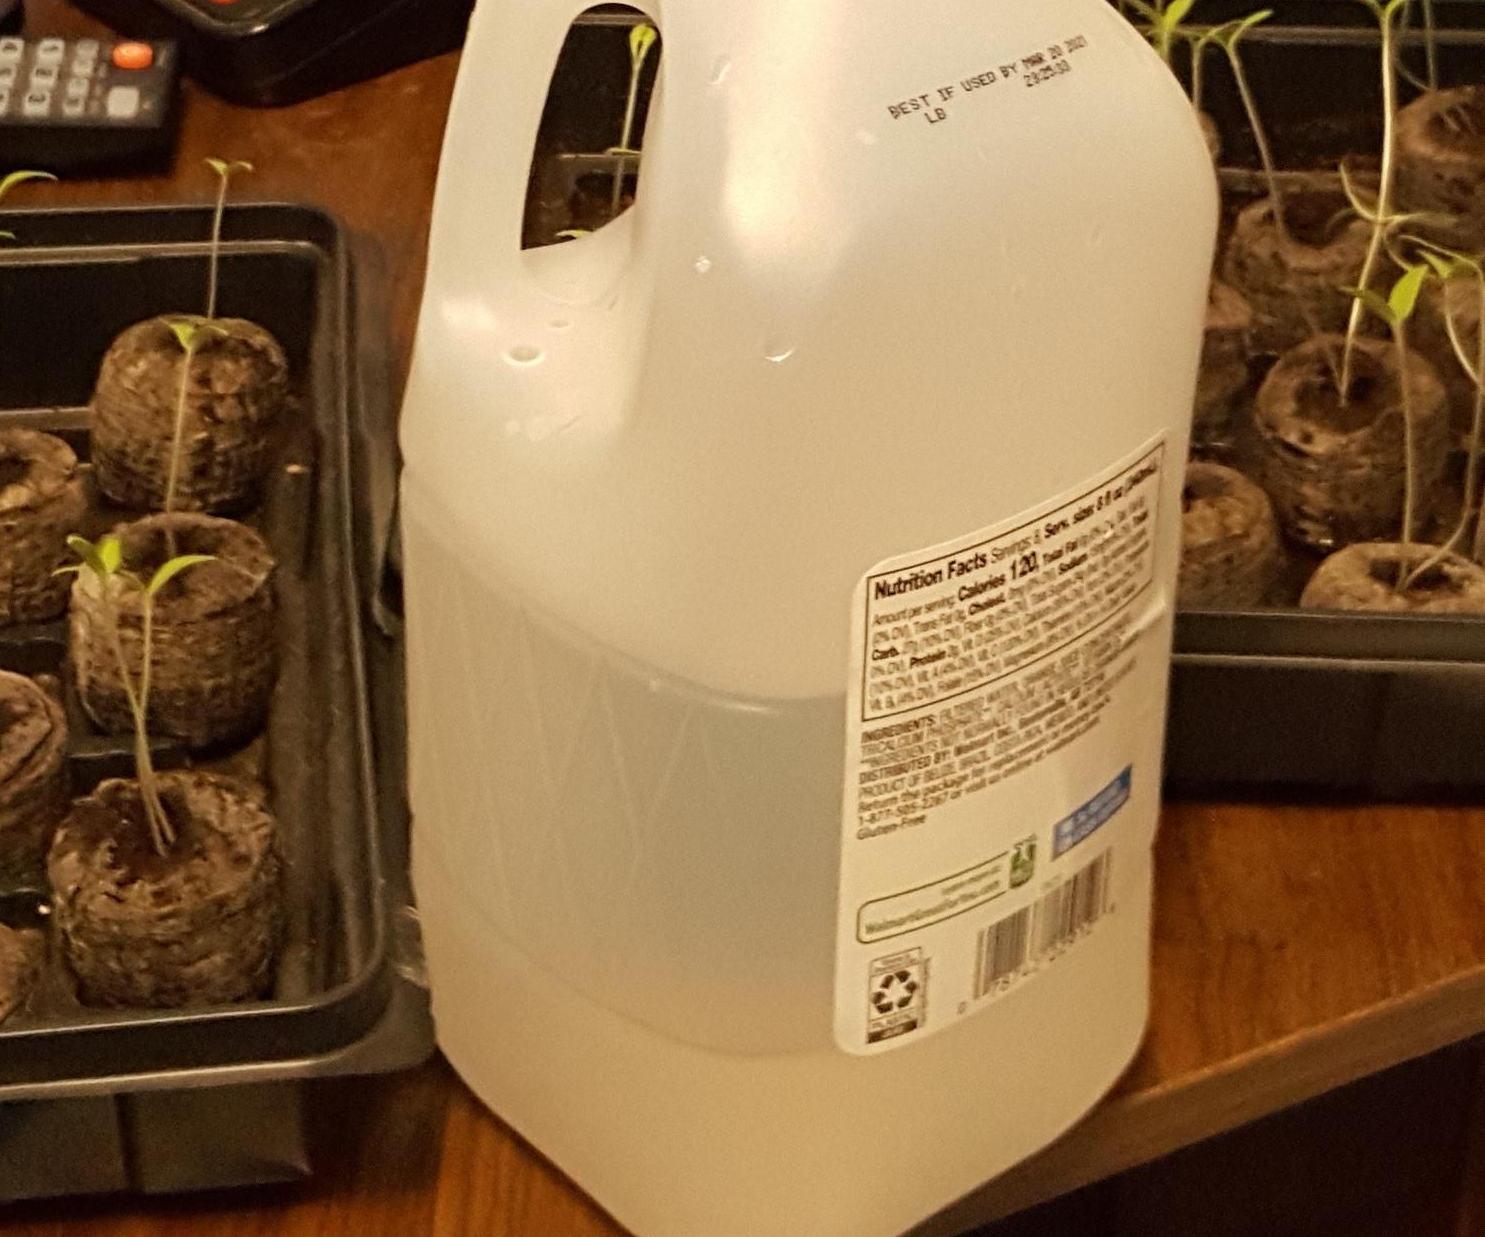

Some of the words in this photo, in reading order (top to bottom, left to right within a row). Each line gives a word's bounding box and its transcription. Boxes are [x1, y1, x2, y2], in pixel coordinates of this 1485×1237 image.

[887, 93, 930, 120] BEST
[936, 85, 955, 102] IF
[960, 71, 996, 92] USED
[999, 62, 1018, 78] BY
[875, 570, 942, 598] Nutrition
[947, 553, 986, 578] Facts
[958, 574, 1005, 601] Calories
[859, 755, 931, 784] DISTRIBUTED
